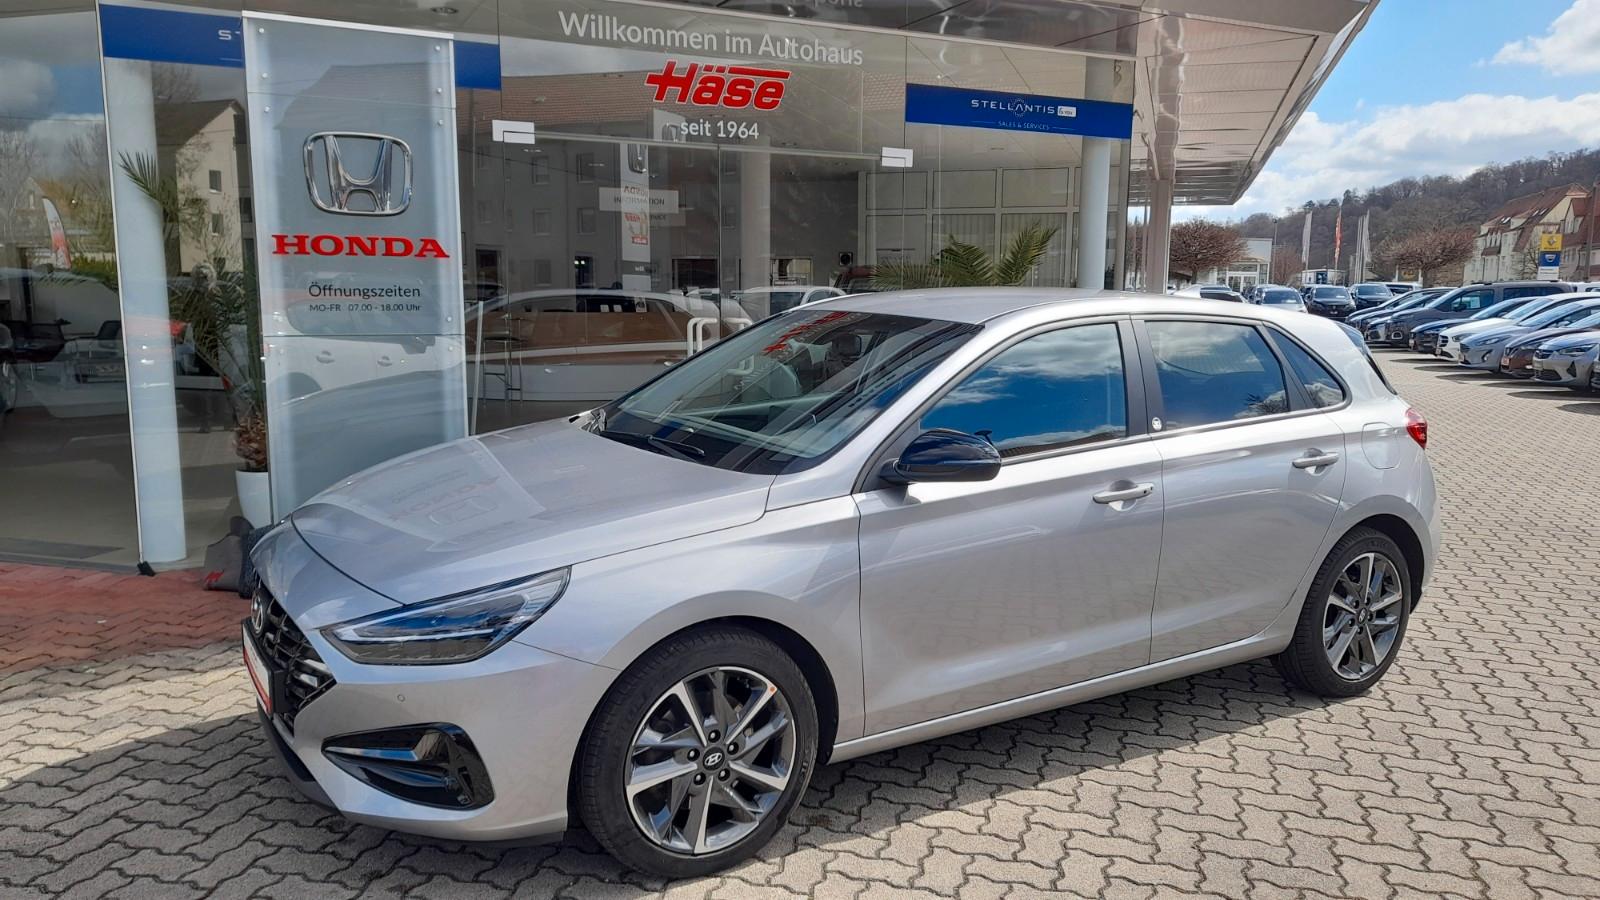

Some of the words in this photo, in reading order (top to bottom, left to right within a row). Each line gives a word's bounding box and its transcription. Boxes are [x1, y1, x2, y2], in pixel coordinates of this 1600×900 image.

[558, 10, 718, 51] Willkommen
[725, 29, 752, 55] im
[758, 36, 863, 66] Autohaus
[644, 60, 791, 111] Häse
[971, 99, 1056, 114] STELLANTIS
[680, 118, 711, 137] seit
[717, 120, 760, 140] 1964
[272, 234, 450, 258] HONDA
[308, 281, 421, 299] Öffnungszeiten
[309, 303, 342, 312] MO-FR
[347, 303, 373, 312] 07.00
[380, 303, 404, 312] 18.00
[405, 304, 422, 312] Uhr
